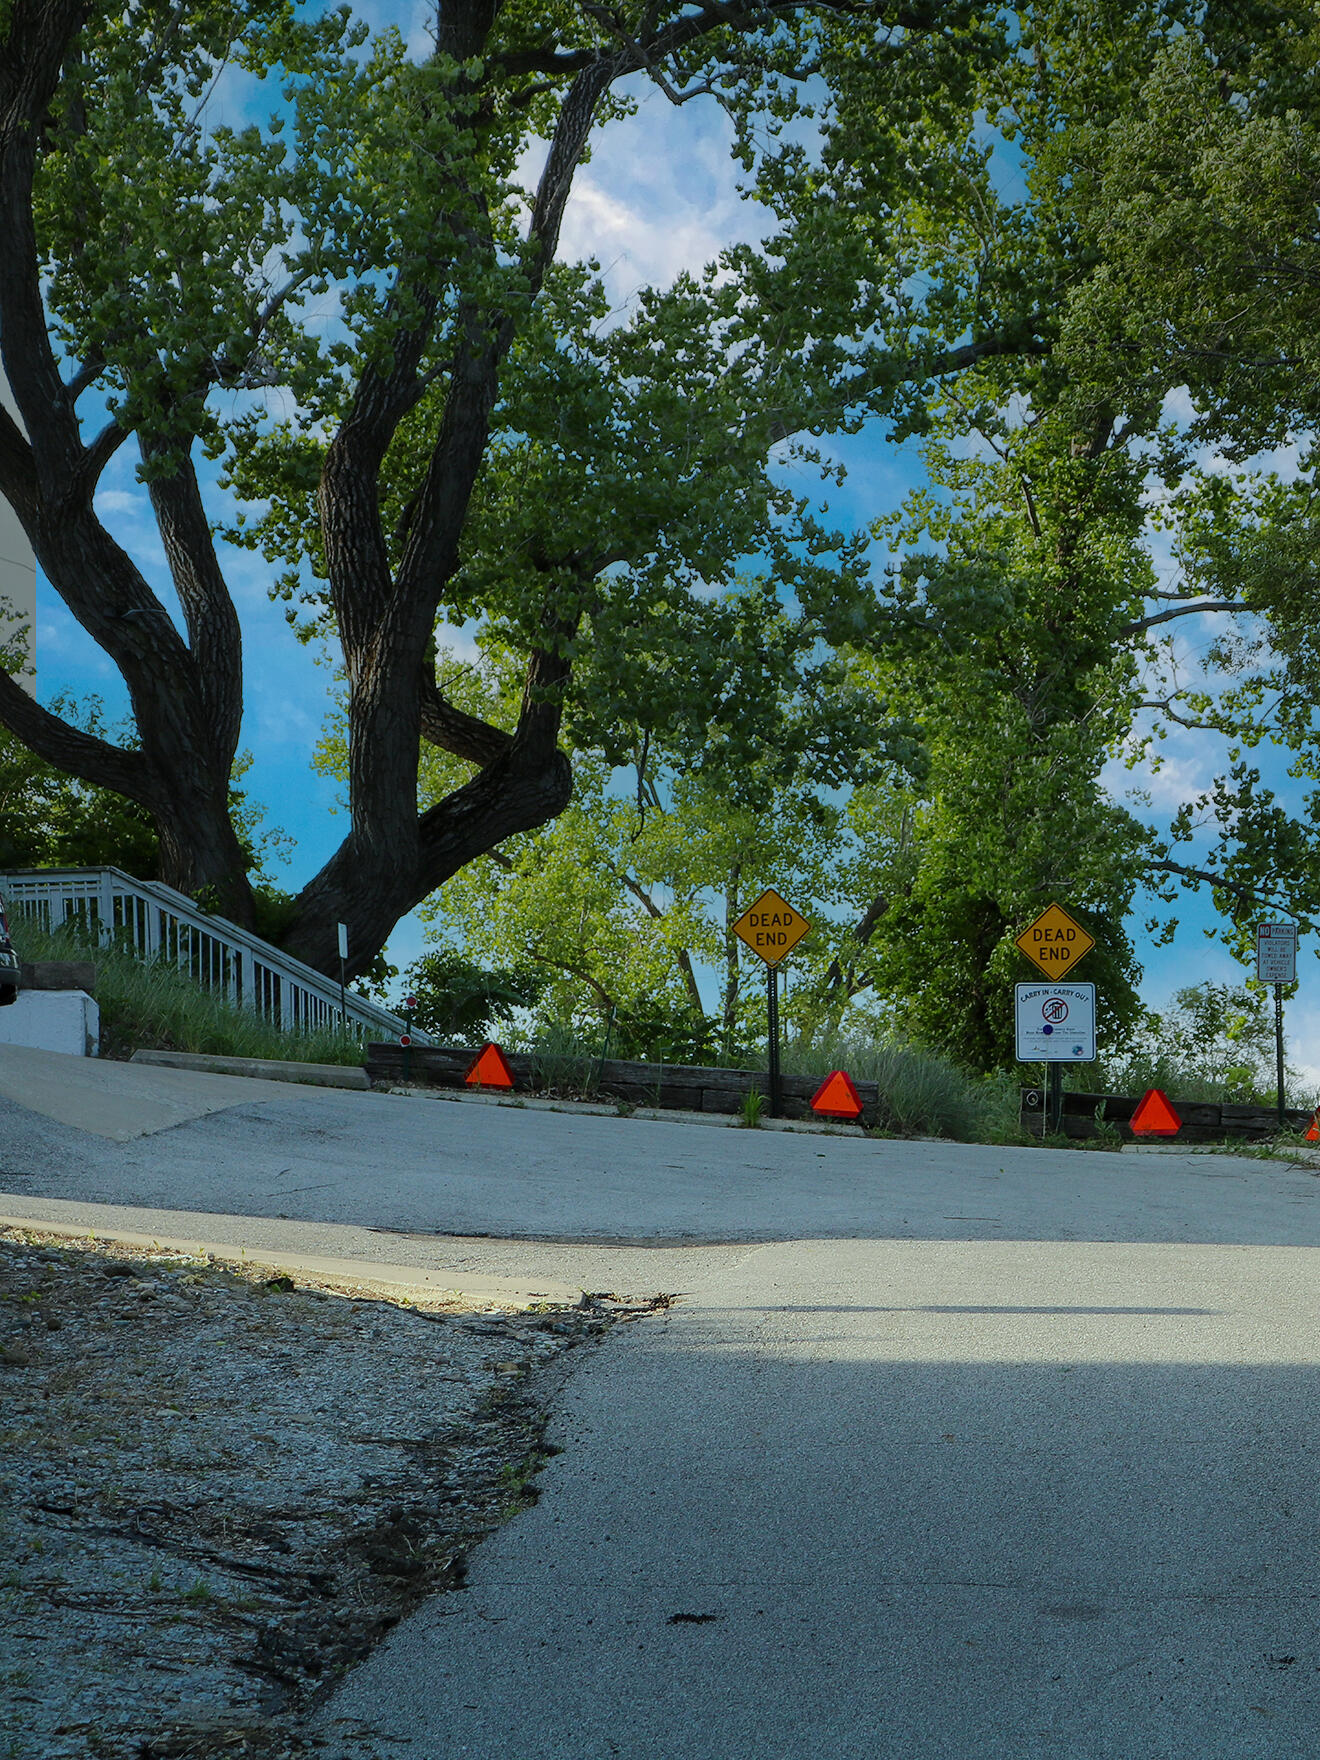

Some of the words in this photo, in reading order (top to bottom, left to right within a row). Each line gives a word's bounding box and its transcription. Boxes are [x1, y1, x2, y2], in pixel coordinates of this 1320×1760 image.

[750, 913, 793, 926] DEAD
[1033, 928, 1076, 942] DEAD
[1260, 926, 1270, 936] NO
[1272, 927, 1294, 936] PARKING
[756, 932, 787, 946] END
[1039, 947, 1070, 960] END
[1020, 990, 1041, 1002] CARRY
[1053, 988, 1074, 996] CARRY
[1074, 992, 1089, 1002] OUT
